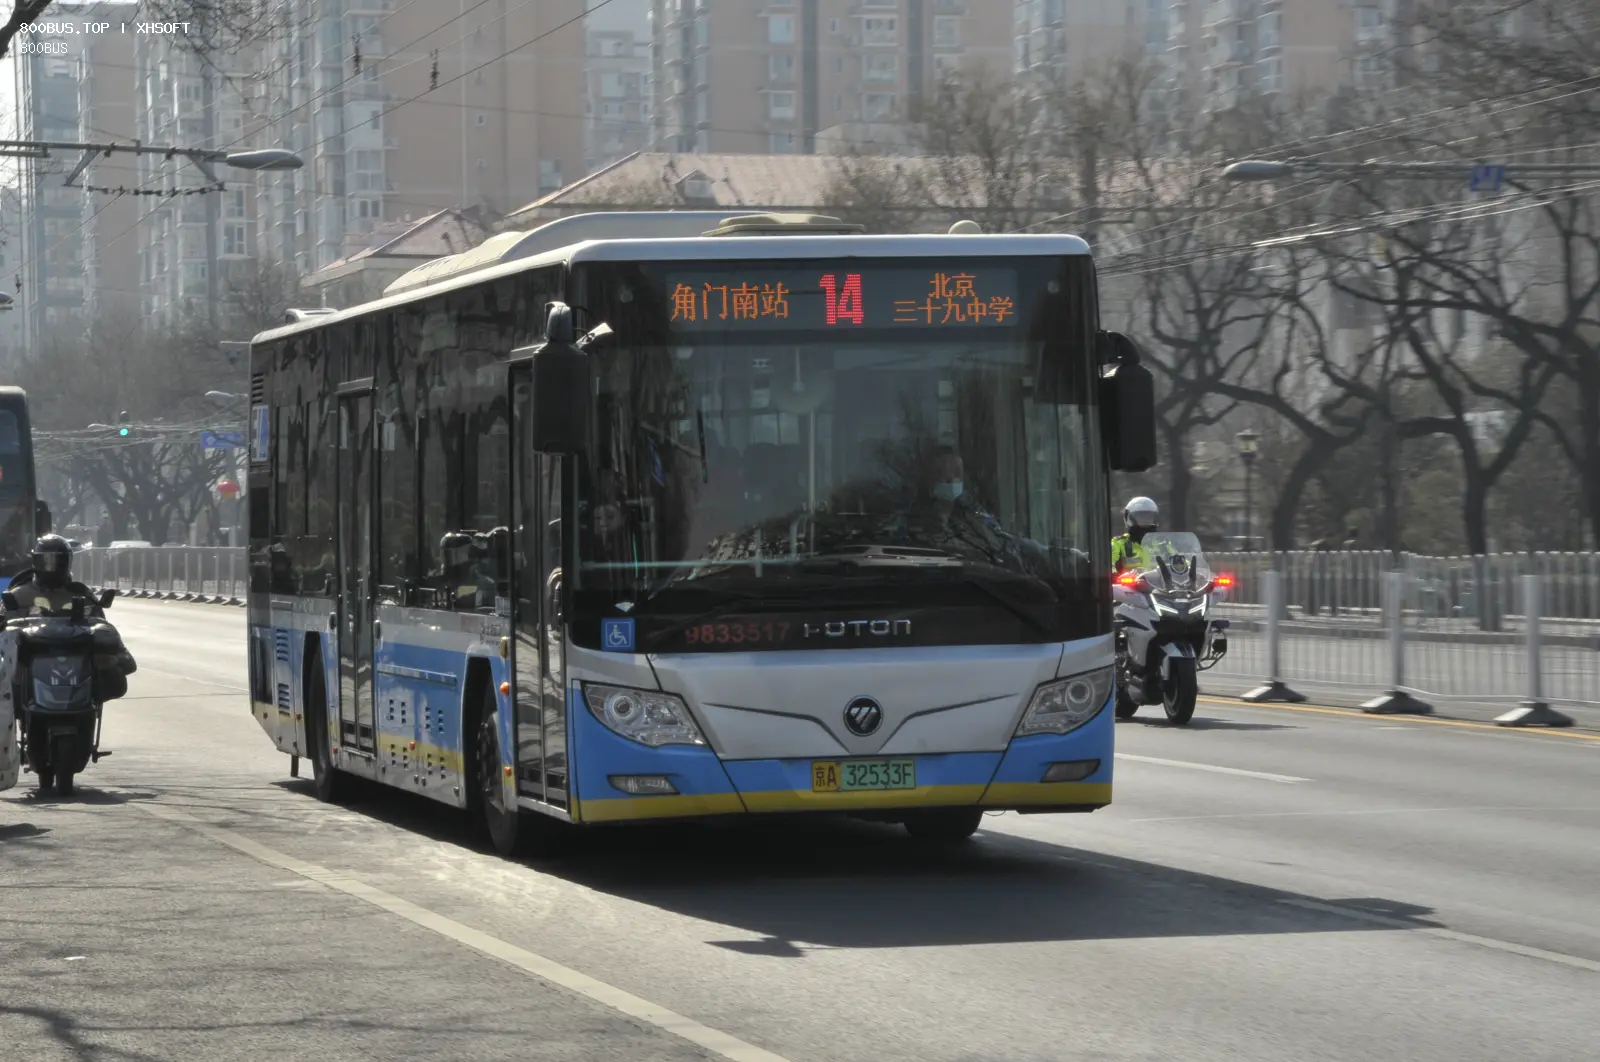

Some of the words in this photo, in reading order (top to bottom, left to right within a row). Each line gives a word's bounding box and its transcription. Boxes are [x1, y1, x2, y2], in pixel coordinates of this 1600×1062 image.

[819, 272, 864, 325] 14
[929, 272, 977, 299] 北京
[670, 281, 790, 322] 角门南站
[893, 296, 1015, 324] 三十九中学
[684, 621, 791, 645] 9833517
[815, 765, 837, 787] 京A
[846, 763, 913, 787] 32533F
